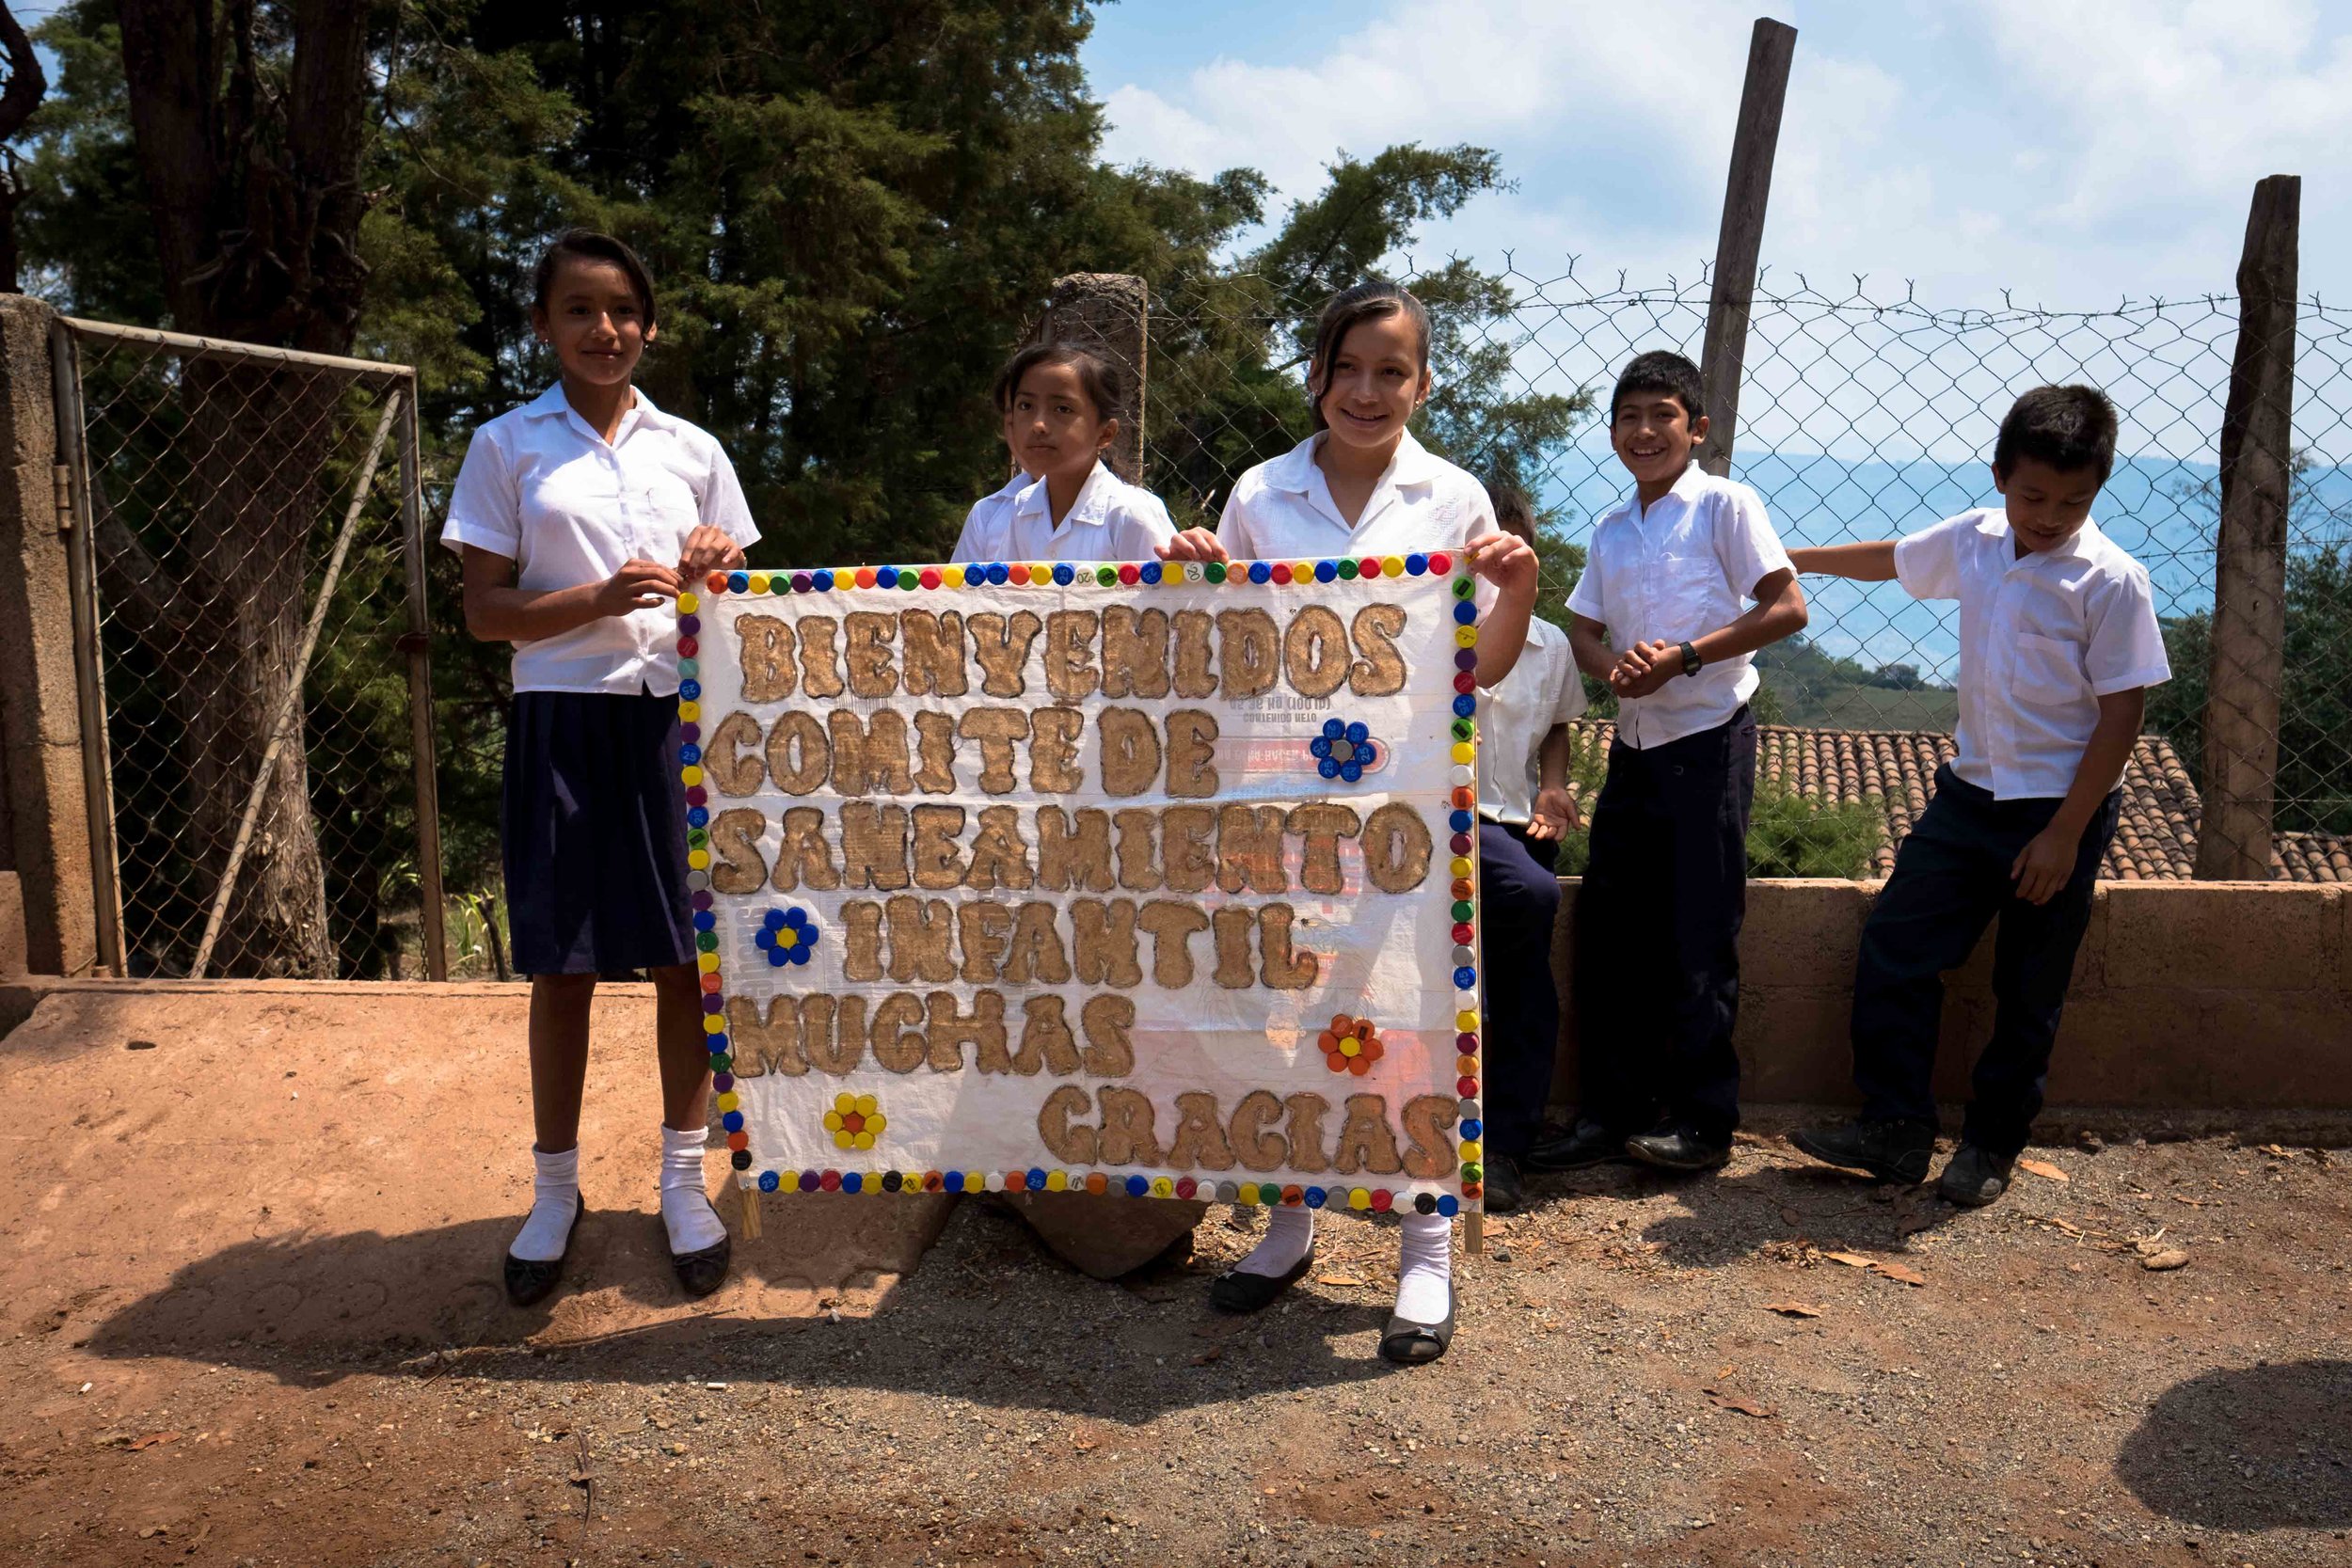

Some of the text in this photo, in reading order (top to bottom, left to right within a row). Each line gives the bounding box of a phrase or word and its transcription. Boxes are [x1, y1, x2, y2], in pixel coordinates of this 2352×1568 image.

[1059, 568, 1069, 582] 25
[735, 602, 1407, 704] BIENVENIDOS
[682, 684, 695, 695] 25
[704, 705, 1220, 799] COMITE DE
[1313, 740, 1327, 754] 25
[1361, 747, 1370, 761] 25
[683, 751, 696, 760] 25
[1325, 760, 1333, 775] 25
[709, 800, 1433, 895] SANEAMIENTO
[838, 895, 1317, 990] INFANTIL
[725, 988, 1136, 1079] MUCHAS
[1037, 1083, 1460, 1180] GRACIAS
[761, 1178, 775, 1191] 25
[1029, 1178, 1042, 1188] 25
